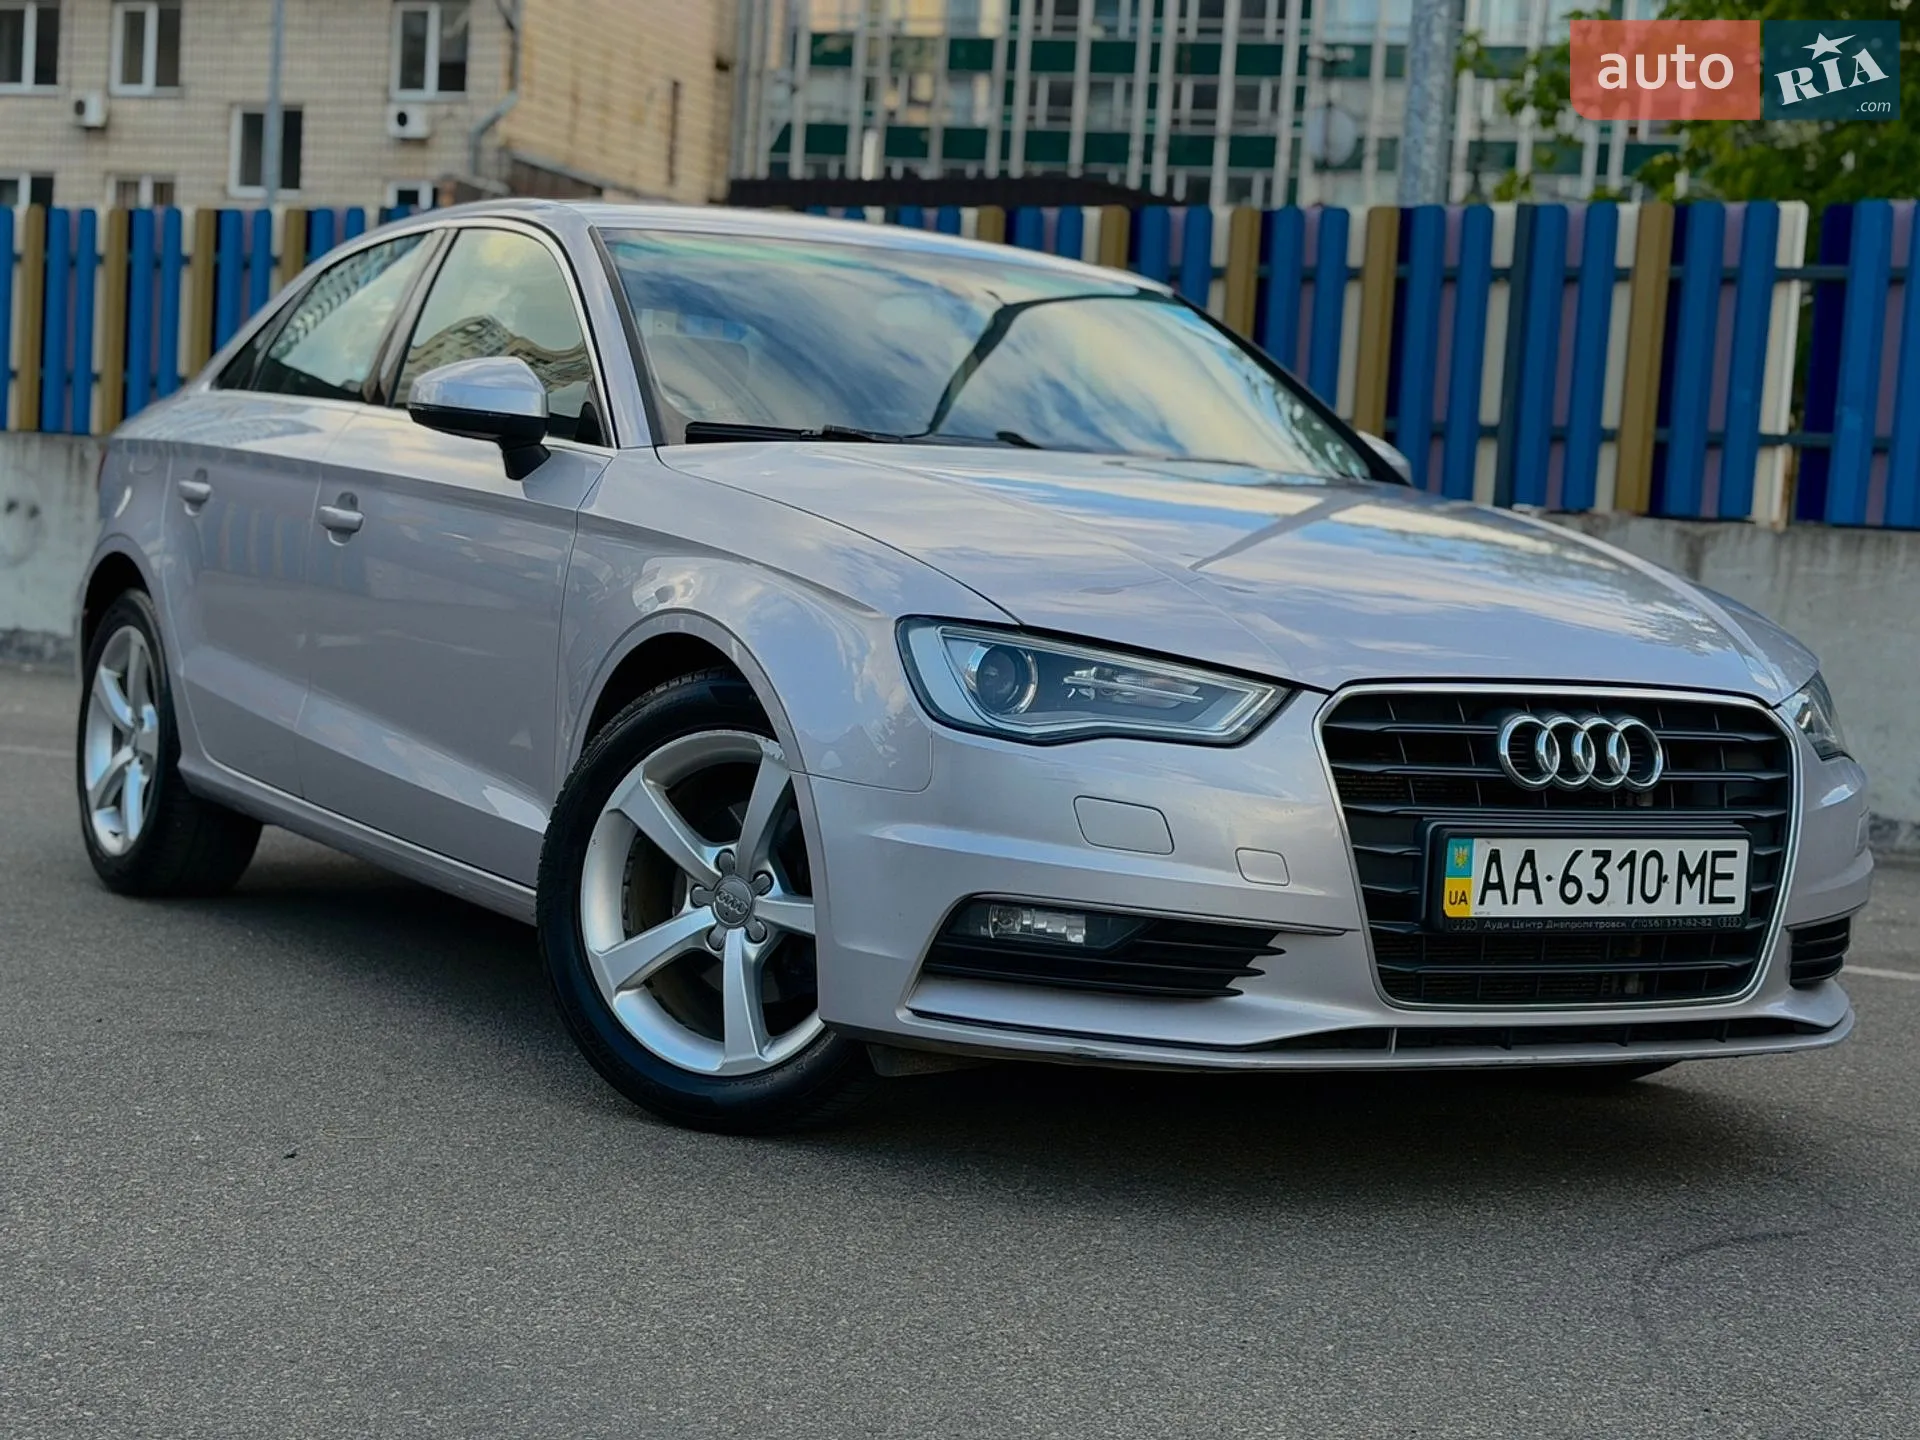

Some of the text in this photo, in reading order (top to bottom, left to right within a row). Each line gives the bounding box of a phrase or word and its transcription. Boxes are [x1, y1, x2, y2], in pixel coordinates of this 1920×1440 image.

[1449, 890, 1468, 905] UA
[1484, 919, 1510, 930] Ауди
[1512, 919, 1543, 930] Центр
